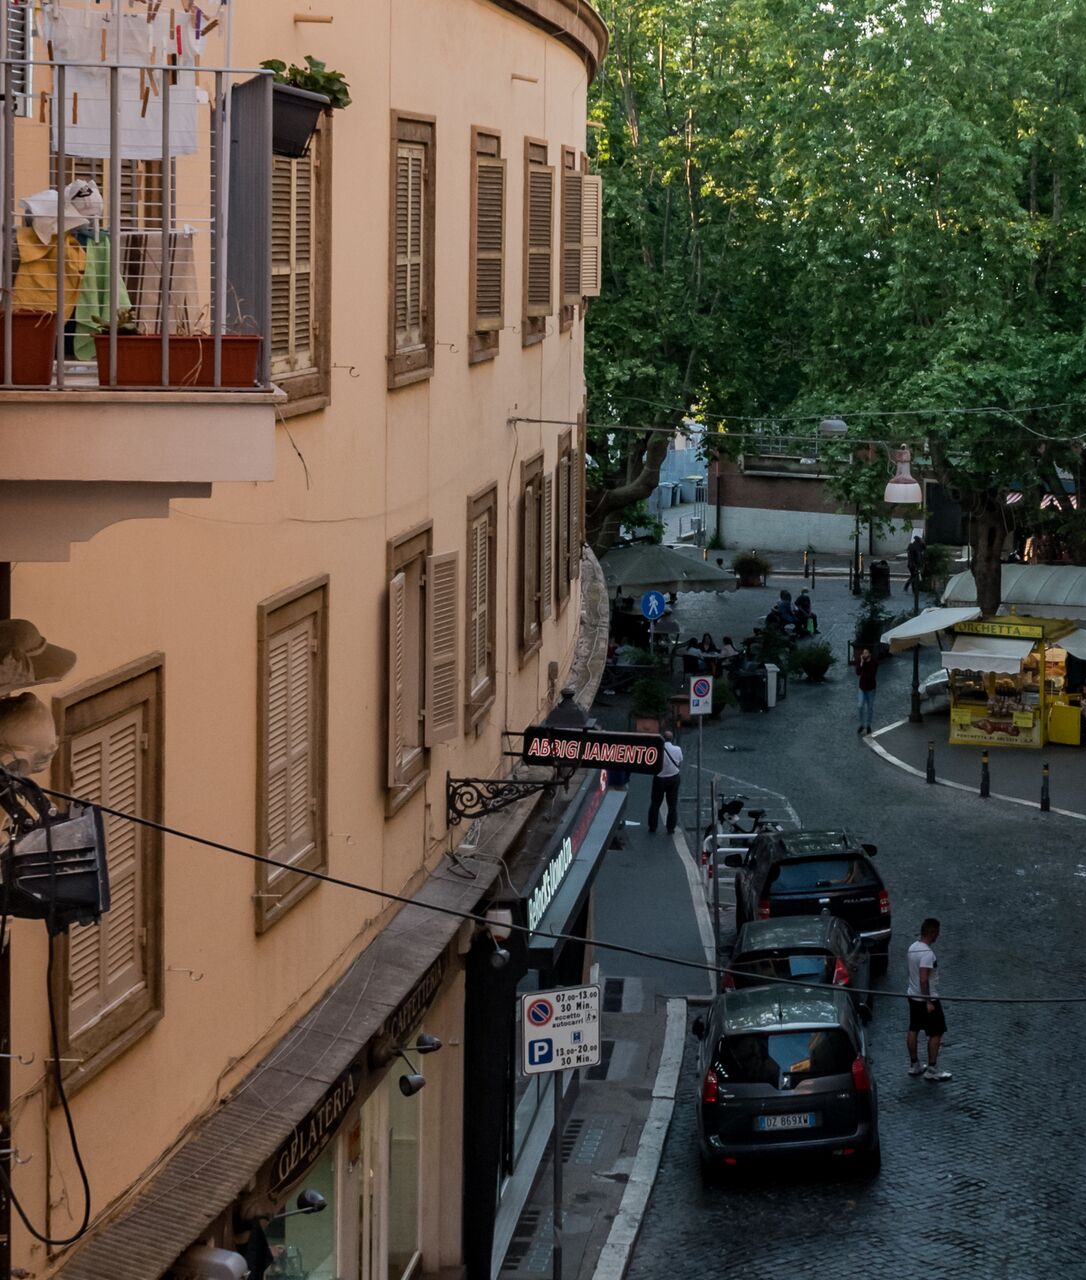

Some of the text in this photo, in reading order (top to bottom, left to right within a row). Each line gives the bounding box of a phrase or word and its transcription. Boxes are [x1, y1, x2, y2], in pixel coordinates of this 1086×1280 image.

[958, 622, 1021, 636] ORCHETTA
[560, 1003, 572, 1013] 30
[554, 1012, 581, 1021] eccetto
[552, 1018, 584, 1028] autocarri
[534, 1041, 549, 1063] P
[560, 1056, 572, 1066] 30
[278, 1072, 357, 1181] GELATERIA
